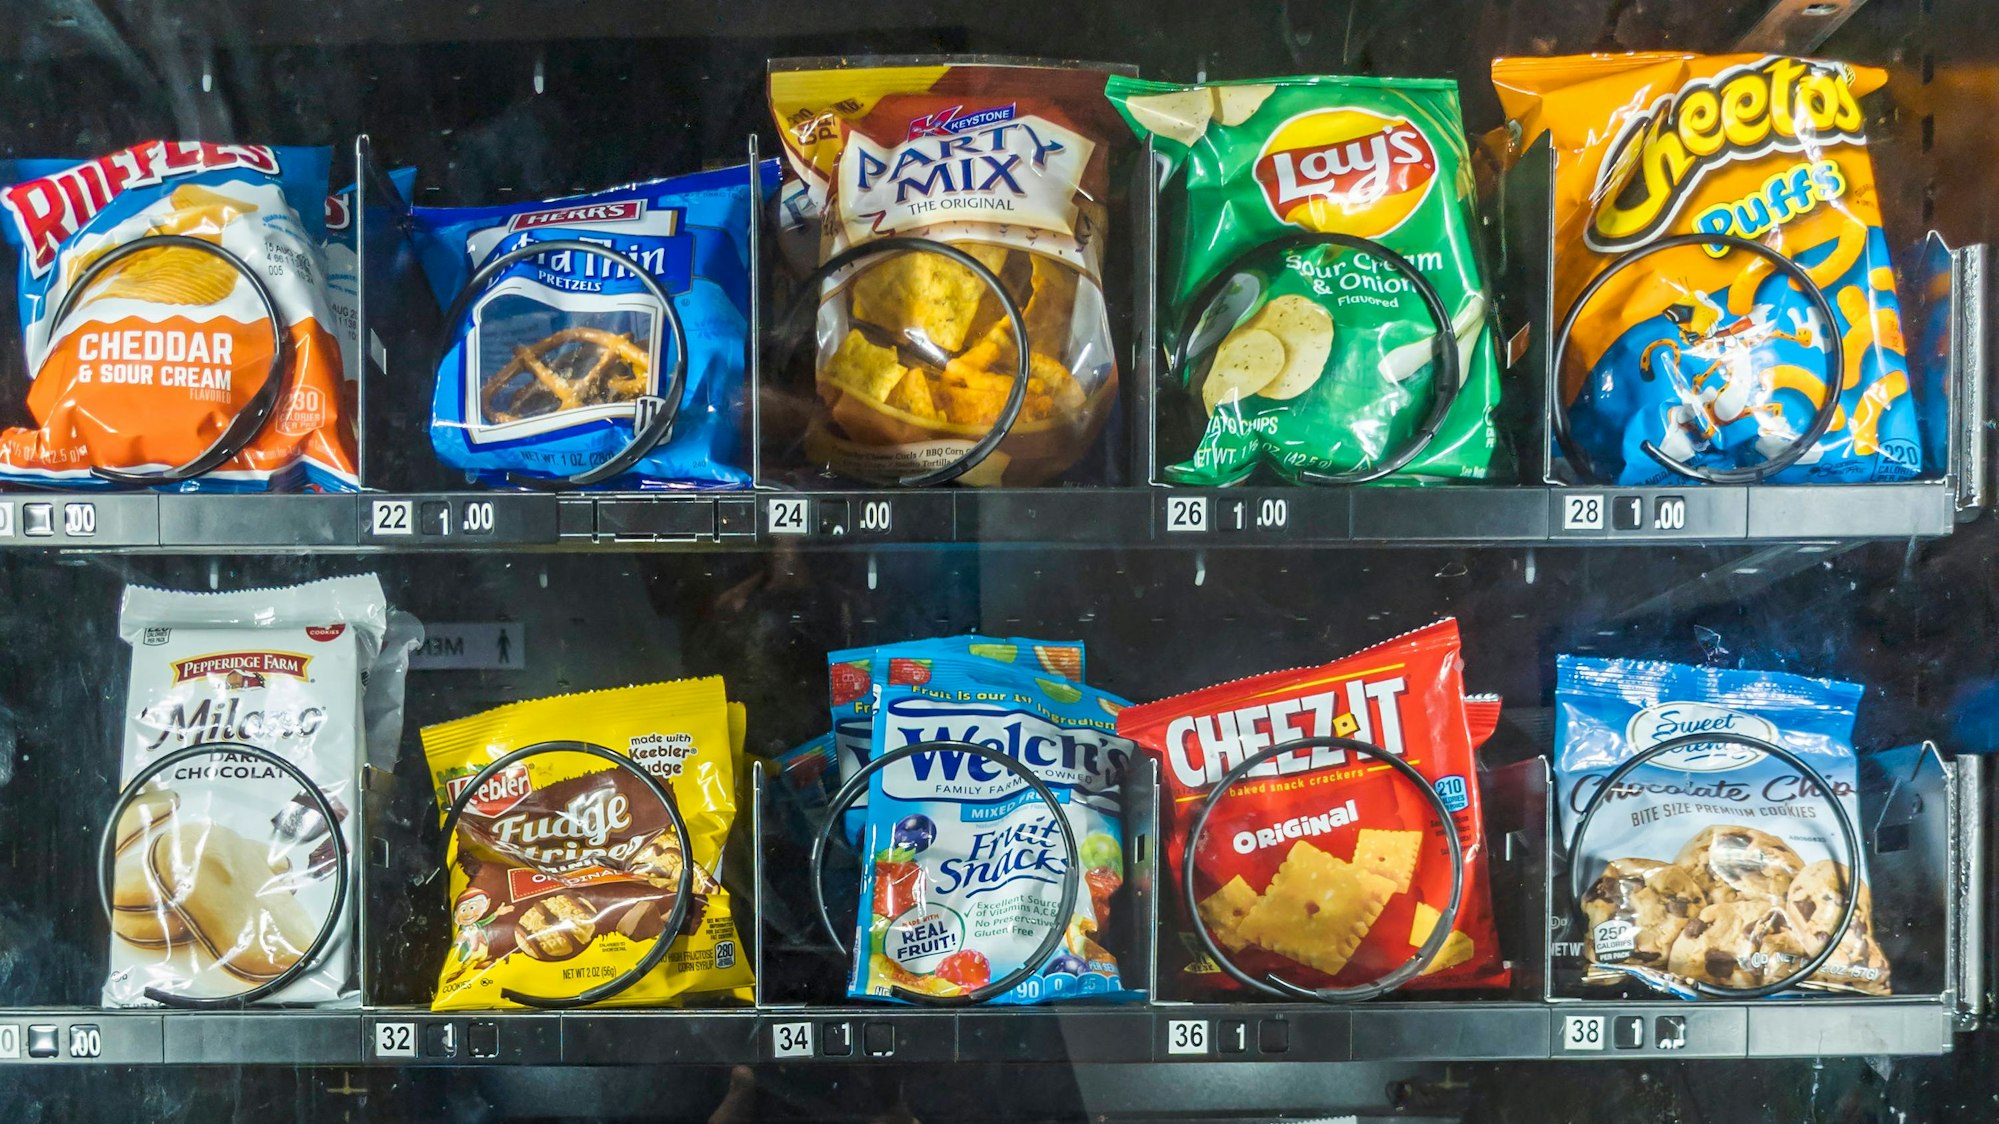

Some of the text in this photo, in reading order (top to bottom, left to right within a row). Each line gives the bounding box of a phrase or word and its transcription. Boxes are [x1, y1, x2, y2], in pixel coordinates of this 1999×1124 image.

[951, 109, 1009, 130] KEYSTONE
[857, 124, 1065, 190] PARTY
[1592, 56, 1866, 242] Cheetos
[1273, 123, 1419, 204] Lay's
[895, 153, 1026, 202] MIX
[5, 139, 280, 279] RUFFLES
[527, 203, 626, 225] HERR'S
[907, 198, 1015, 217] THE ORIGINAL
[1695, 162, 1845, 255] Puffs
[268, 265, 283, 276] 005
[1286, 255, 1346, 279] Sour
[539, 270, 602, 292] PRETZELS
[1313, 273, 1417, 295] & Onion
[332, 304, 348, 317] AUG
[1337, 294, 1399, 308] Flavored
[79, 331, 233, 366] CHEDDAR
[79, 364, 232, 391] & SOUR CREAM
[190, 387, 231, 404] FLAVORED
[521, 450, 540, 462] NET
[542, 451, 559, 466] WT.
[570, 453, 587, 467] OZ.
[895, 450, 917, 460] Curls
[926, 448, 944, 457] BBQ
[945, 446, 964, 456] Corn
[1883, 444, 1919, 466] 220
[379, 502, 493, 535] 22 1 .00
[774, 501, 890, 529] 24 .00
[1173, 499, 1286, 529] 26 1 .00
[1571, 498, 1685, 529] 28 1 .00
[310, 629, 340, 637] COOKIES
[183, 654, 299, 678] PEPPERIDGE FARM
[912, 684, 951, 701] Fruit
[958, 690, 971, 700] is
[977, 692, 1007, 701] our
[1037, 702, 1117, 731] Ingredien
[1655, 710, 1744, 733] Sweet
[631, 733, 691, 746] made with
[898, 720, 1130, 786] Welch's
[175, 766, 292, 780] CHOCOLAT
[641, 760, 682, 777] udge
[453, 775, 529, 804] Kebler
[935, 784, 981, 795] FAMILY
[1045, 769, 1092, 785] OWNED
[1229, 768, 1364, 798] baked snack crackers
[1437, 778, 1462, 797] 210
[1761, 774, 1856, 803] Chip
[492, 787, 630, 845] Fudge
[971, 801, 1016, 819] MIXED
[1019, 789, 1061, 804] FRUT
[1631, 802, 1816, 827] BITE SIZE PREMIUM COOKIES
[968, 815, 1061, 862] Fruit
[976, 894, 1025, 909] Excellent
[976, 909, 987, 918] of
[990, 902, 1031, 917] Vitamins
[902, 920, 948, 944] REAL
[974, 925, 1034, 938] Gluten Free
[975, 919, 990, 928] No
[683, 948, 713, 962] FRUCTOSE
[717, 943, 733, 958] 280
[897, 933, 956, 959] FRUIT!
[562, 968, 575, 980] NET
[576, 968, 586, 978] WT
[592, 967, 600, 978] OZ
[677, 961, 695, 973] CORN
[695, 960, 713, 971] SYRUP
[443, 980, 471, 994] COOKIES
[1016, 982, 1039, 998] 90
[382, 1022, 453, 1050] 32 1
[780, 1022, 850, 1051] 34 1
[1175, 1023, 1245, 1050] 36 1
[1572, 1019, 1599, 1043] 38
[1631, 1018, 1641, 1046] 1
